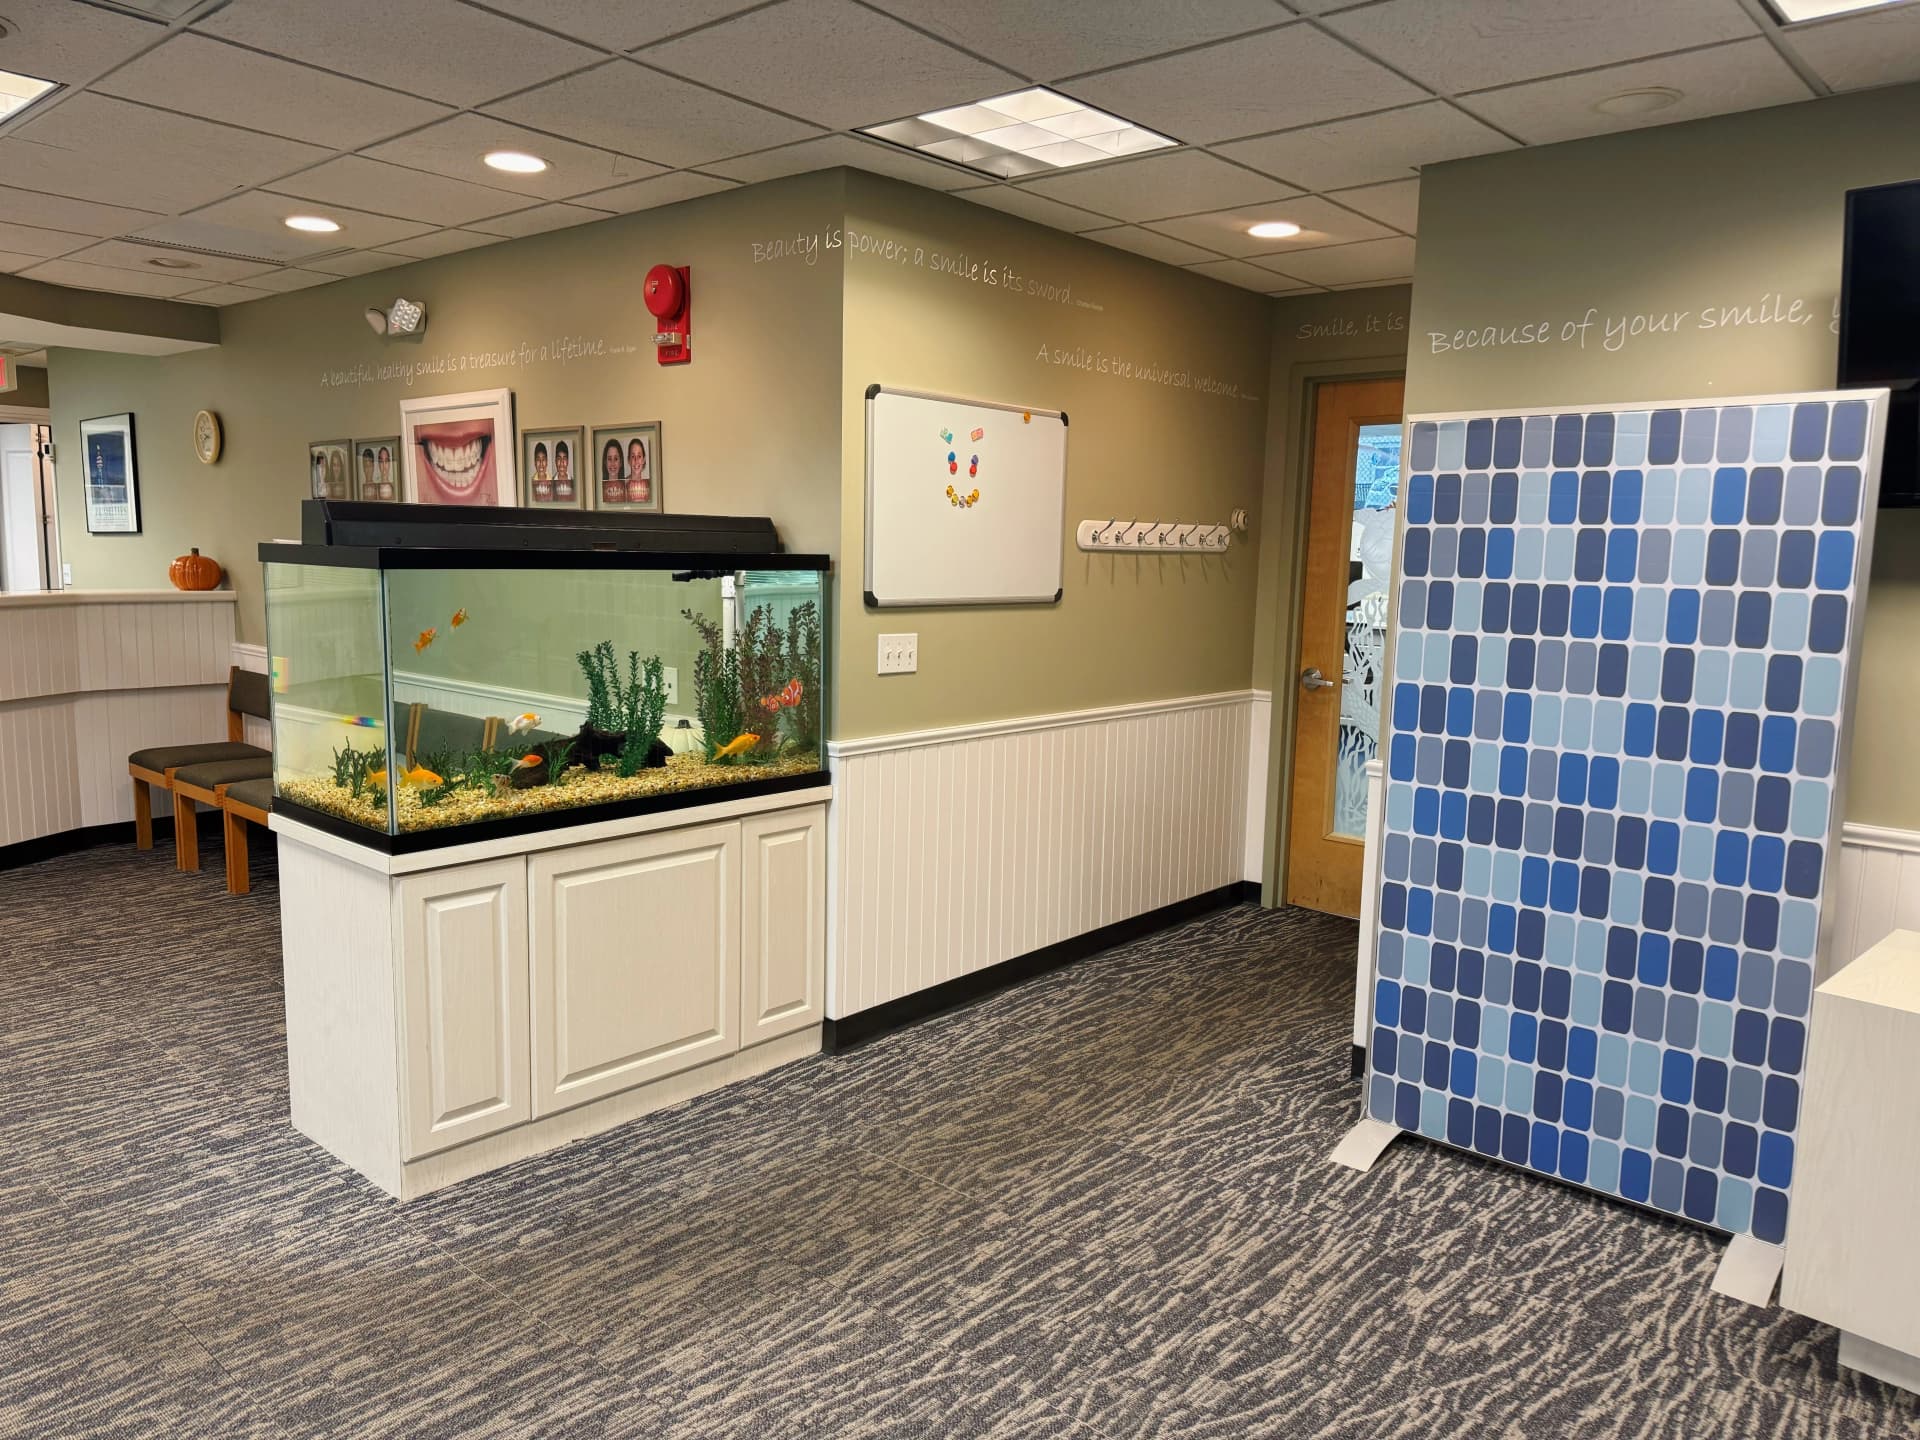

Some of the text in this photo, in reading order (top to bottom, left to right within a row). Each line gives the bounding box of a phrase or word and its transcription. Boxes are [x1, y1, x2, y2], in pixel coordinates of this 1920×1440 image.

[753, 234, 819, 266] Beauty
[825, 223, 842, 249] is
[914, 248, 924, 267] a
[929, 253, 978, 281] smile
[983, 260, 998, 286] is
[1002, 265, 1023, 292] its
[1366, 313, 1383, 333] it
[1386, 312, 1405, 330] is
[1430, 323, 1550, 355] Because
[1561, 308, 1598, 349] of
[1602, 312, 1691, 352] your
[1698, 293, 1814, 331] smile,
[321, 371, 329, 387] A
[377, 360, 413, 386] healthy
[416, 354, 445, 376] smile
[447, 351, 457, 372] is
[460, 356, 467, 371] a
[469, 347, 516, 369] treasure
[519, 341, 537, 368] for
[540, 345, 548, 361] a
[1035, 344, 1049, 363] A
[1053, 347, 1092, 371] smile
[1096, 351, 1109, 373] is
[1112, 357, 1132, 379] the
[1135, 362, 1192, 389] universal
